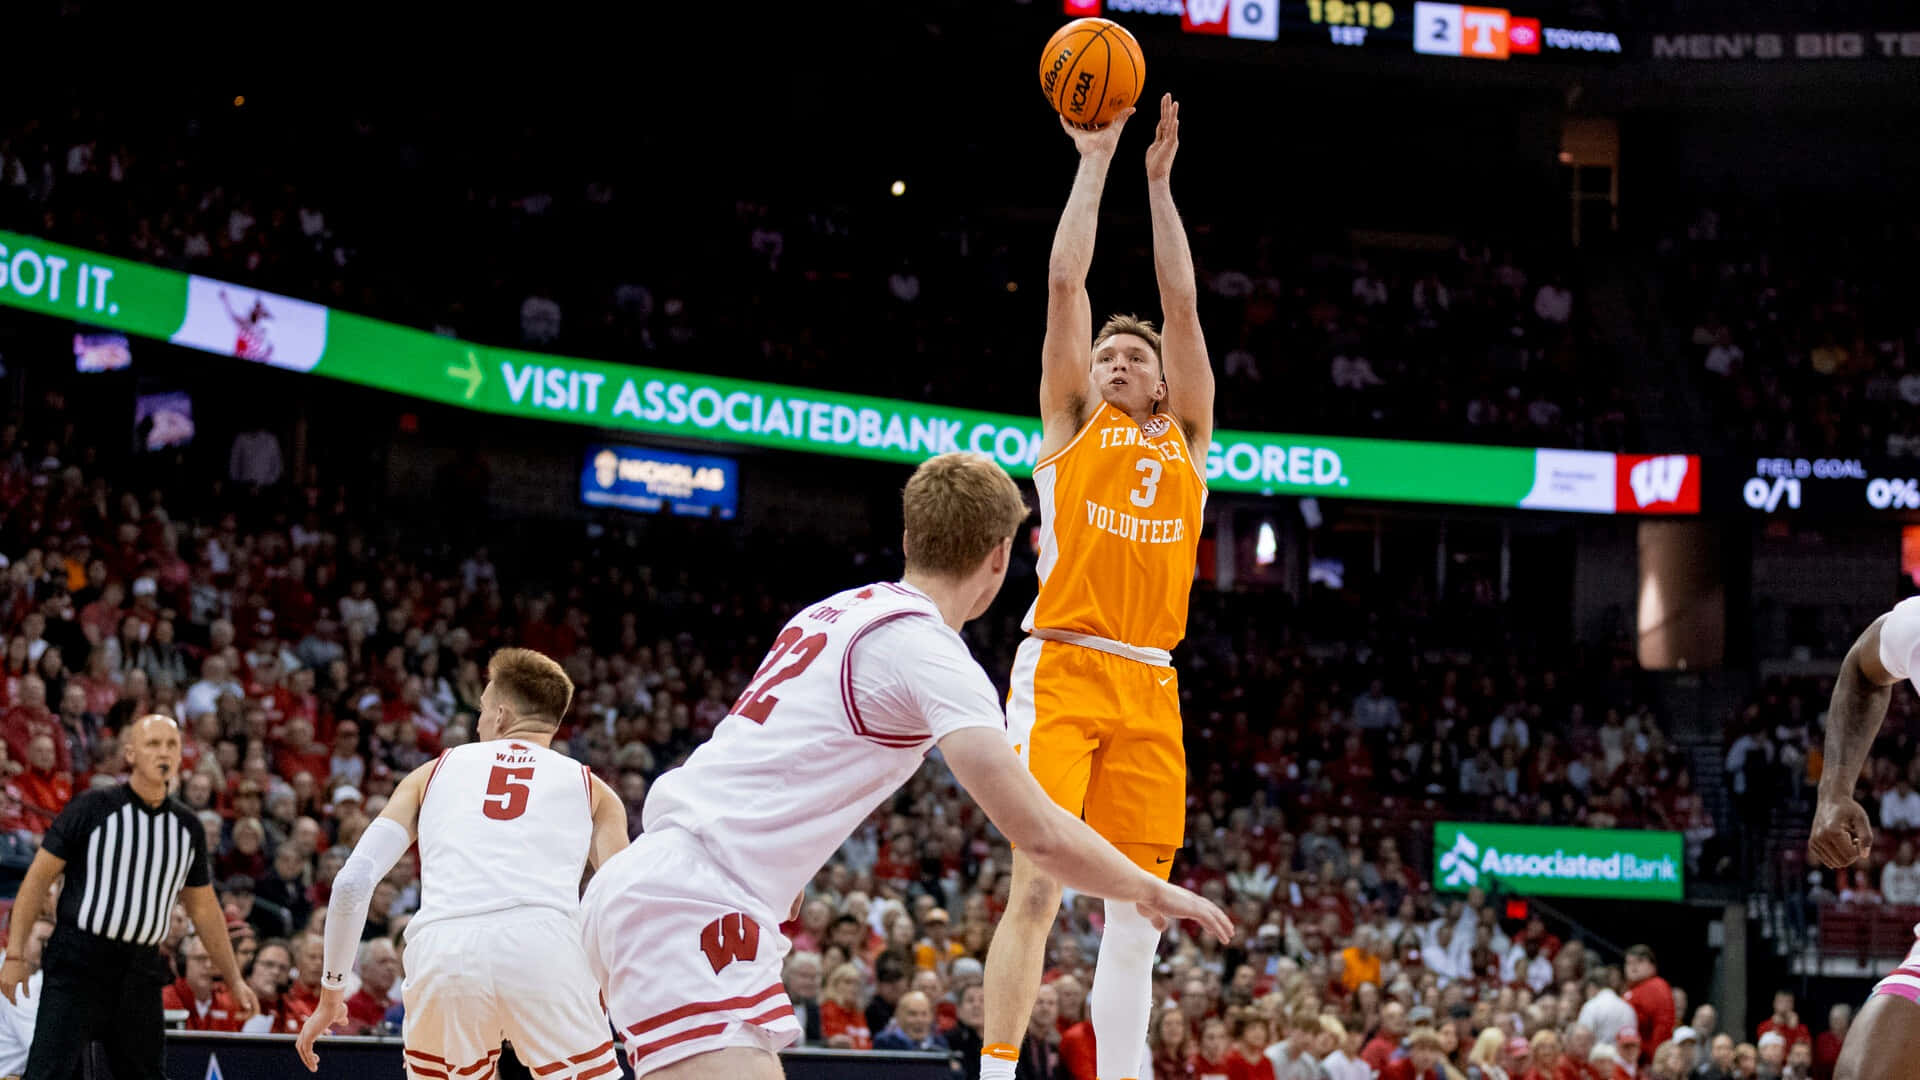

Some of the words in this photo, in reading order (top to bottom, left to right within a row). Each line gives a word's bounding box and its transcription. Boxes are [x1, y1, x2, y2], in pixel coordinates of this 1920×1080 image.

[1242, 1, 1263, 25] 0
[1307, 0, 1394, 29] 19:19
[1431, 17, 1450, 40] 2
[1463, 12, 1506, 53] T
[1329, 25, 1366, 45] 1ST
[1543, 27, 1622, 53] TOYOTA
[1652, 33, 1784, 59] MEN'S
[1794, 32, 1865, 59] BIG
[1068, 71, 1095, 114] NCAA
[77, 262, 119, 316] IT.
[501, 361, 605, 414] VISIT
[611, 378, 1042, 467] ASSOCIATEDBANKCO
[1129, 457, 1163, 509] 3
[1629, 454, 1689, 509] W
[1756, 457, 1811, 479] FIELD
[1812, 458, 1868, 479] GOAL
[1743, 474, 1802, 513] 0/1
[1866, 477, 1920, 510] 0%
[1085, 499, 1185, 545] VOLUNTEER
[728, 626, 828, 726] 22
[482, 765, 536, 822] 5
[699, 911, 761, 976] W
